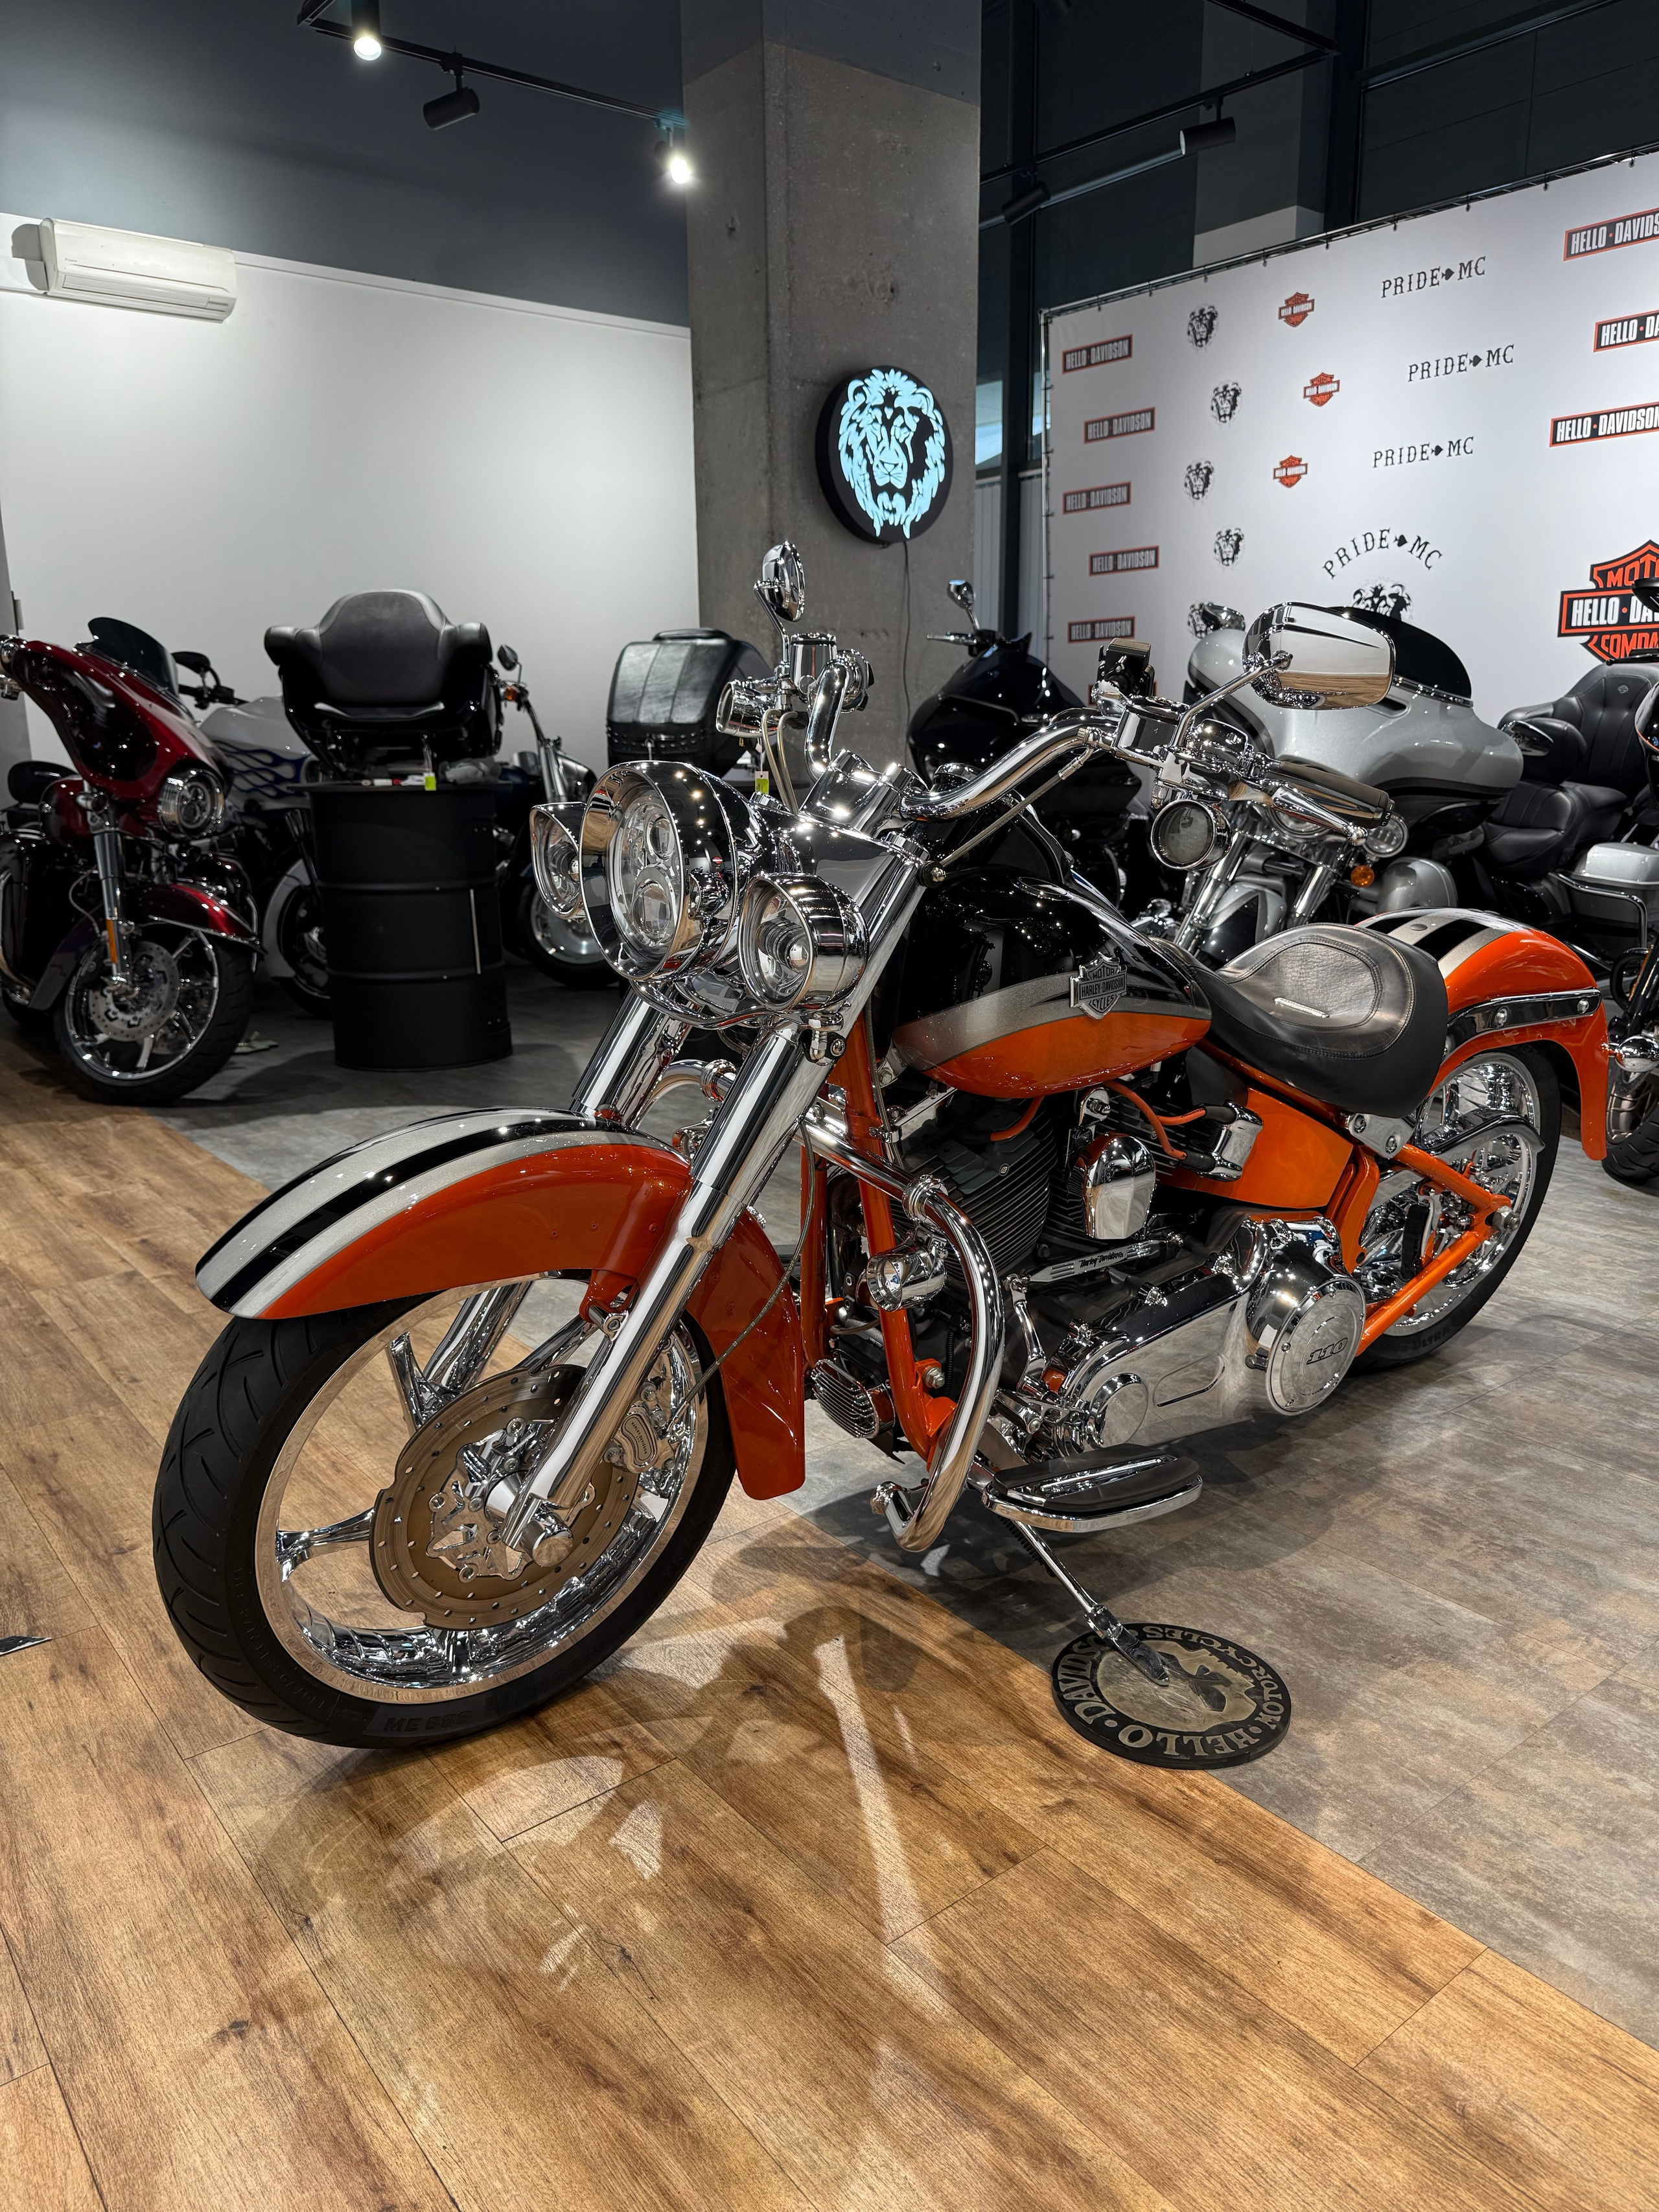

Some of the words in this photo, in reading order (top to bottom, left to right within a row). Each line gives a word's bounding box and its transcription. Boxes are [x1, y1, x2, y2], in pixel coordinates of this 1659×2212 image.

[1571, 226, 1607, 255] HELLO
[1381, 266, 1441, 298] PRIDE
[1457, 256, 1486, 281] MC
[1601, 319, 1638, 347] HELLO
[1065, 349, 1087, 371] HELLO
[1091, 338, 1130, 364] DAVIDSON
[1408, 353, 1468, 382] PRIDE
[1485, 344, 1514, 368] MC
[1087, 420, 1109, 440] HELLO
[1113, 411, 1152, 436] DAVIDSON
[1556, 417, 1592, 442] HELLO
[1373, 442, 1430, 468] PRIDE
[1446, 436, 1474, 458] MC
[1065, 493, 1087, 512] HELLO
[1090, 485, 1128, 507] DAVIDSON
[1092, 555, 1114, 573] HELLO
[1117, 549, 1155, 570] DAVIDSON
[1322, 528, 1391, 580] PRIDE
[1408, 535, 1443, 572] MC
[1571, 596, 1620, 627] HELLO
[1071, 623, 1091, 641] HELLO
[1095, 619, 1132, 639] DAVIDSON
[1082, 976, 1124, 997] HARLEY-DAVIDSON
[1093, 966, 1115, 979] MOTOR
[1092, 994, 1114, 1010] CYCLES
[1306, 1337, 1348, 1365] 110
[631, 1422, 648, 1455] HARLEY-DAVIDSON
[1058, 1635, 1116, 1725] DAVIDS
[1143, 1625, 1285, 1730] MOTORCYCLES
[383, 1717, 419, 1732] ME
[425, 1710, 474, 1730] 888
[1117, 1725, 1260, 1756] HELLO
